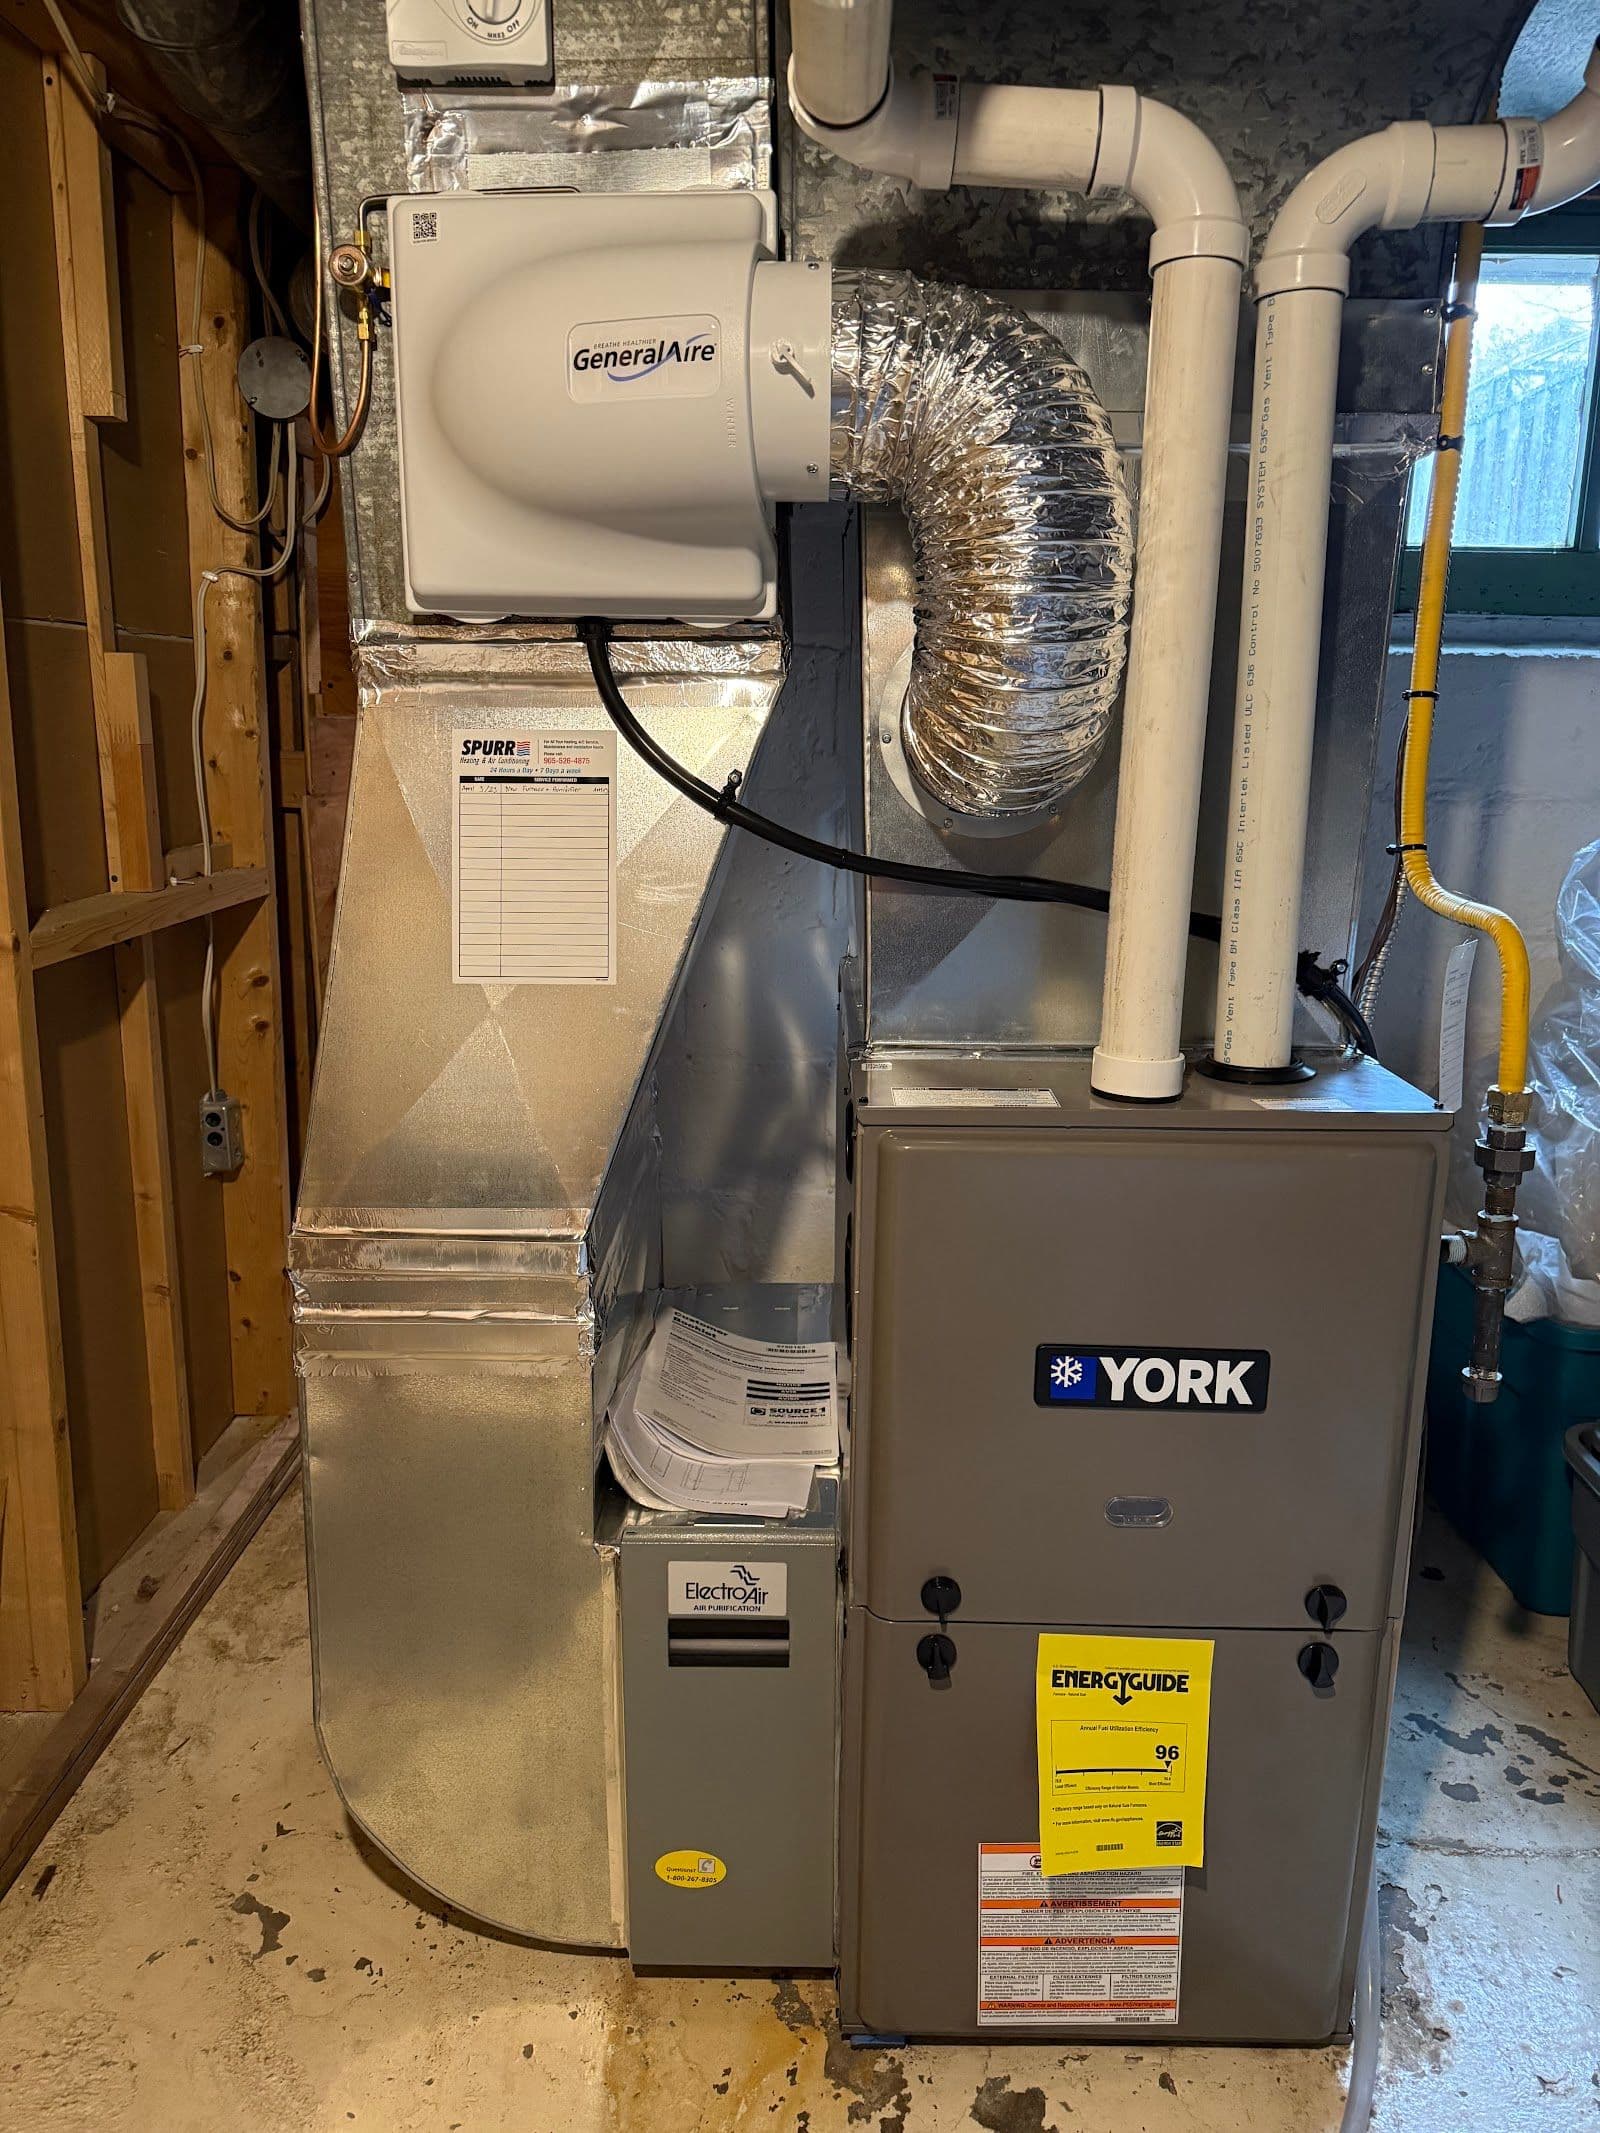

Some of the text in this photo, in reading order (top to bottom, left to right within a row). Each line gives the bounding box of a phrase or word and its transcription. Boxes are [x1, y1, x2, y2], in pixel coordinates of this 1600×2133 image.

[467, 17, 479, 29] ON
[506, 19, 520, 32] OFF
[594, 338, 656, 350] BREATHE HEALTHIER
[1265, 315, 1276, 350] Type
[573, 340, 716, 371] GeneralAire
[1263, 357, 1273, 390] Vent
[1256, 461, 1267, 509] SYSTEM
[1252, 580, 1260, 595] No
[1248, 604, 1260, 656] Control
[1244, 694, 1254, 716] ULC
[462, 740, 516, 756] SPURR
[1242, 724, 1252, 769] Listed
[460, 756, 480, 766] Heating
[498, 757, 530, 766] Conditioning
[1238, 776, 1249, 833] Intertek
[1232, 898, 1241, 933] Class
[1228, 961, 1237, 988] Type
[1226, 996, 1235, 1022] Vent
[673, 1316, 717, 1340] Booklet
[674, 1311, 728, 1336] Customer
[1099, 1356, 1256, 1406] YORK
[686, 1582, 769, 1605] ElectroAir
[1052, 1670, 1190, 1693] ENERGYGUIDE
[1155, 1744, 1180, 1760] 96
